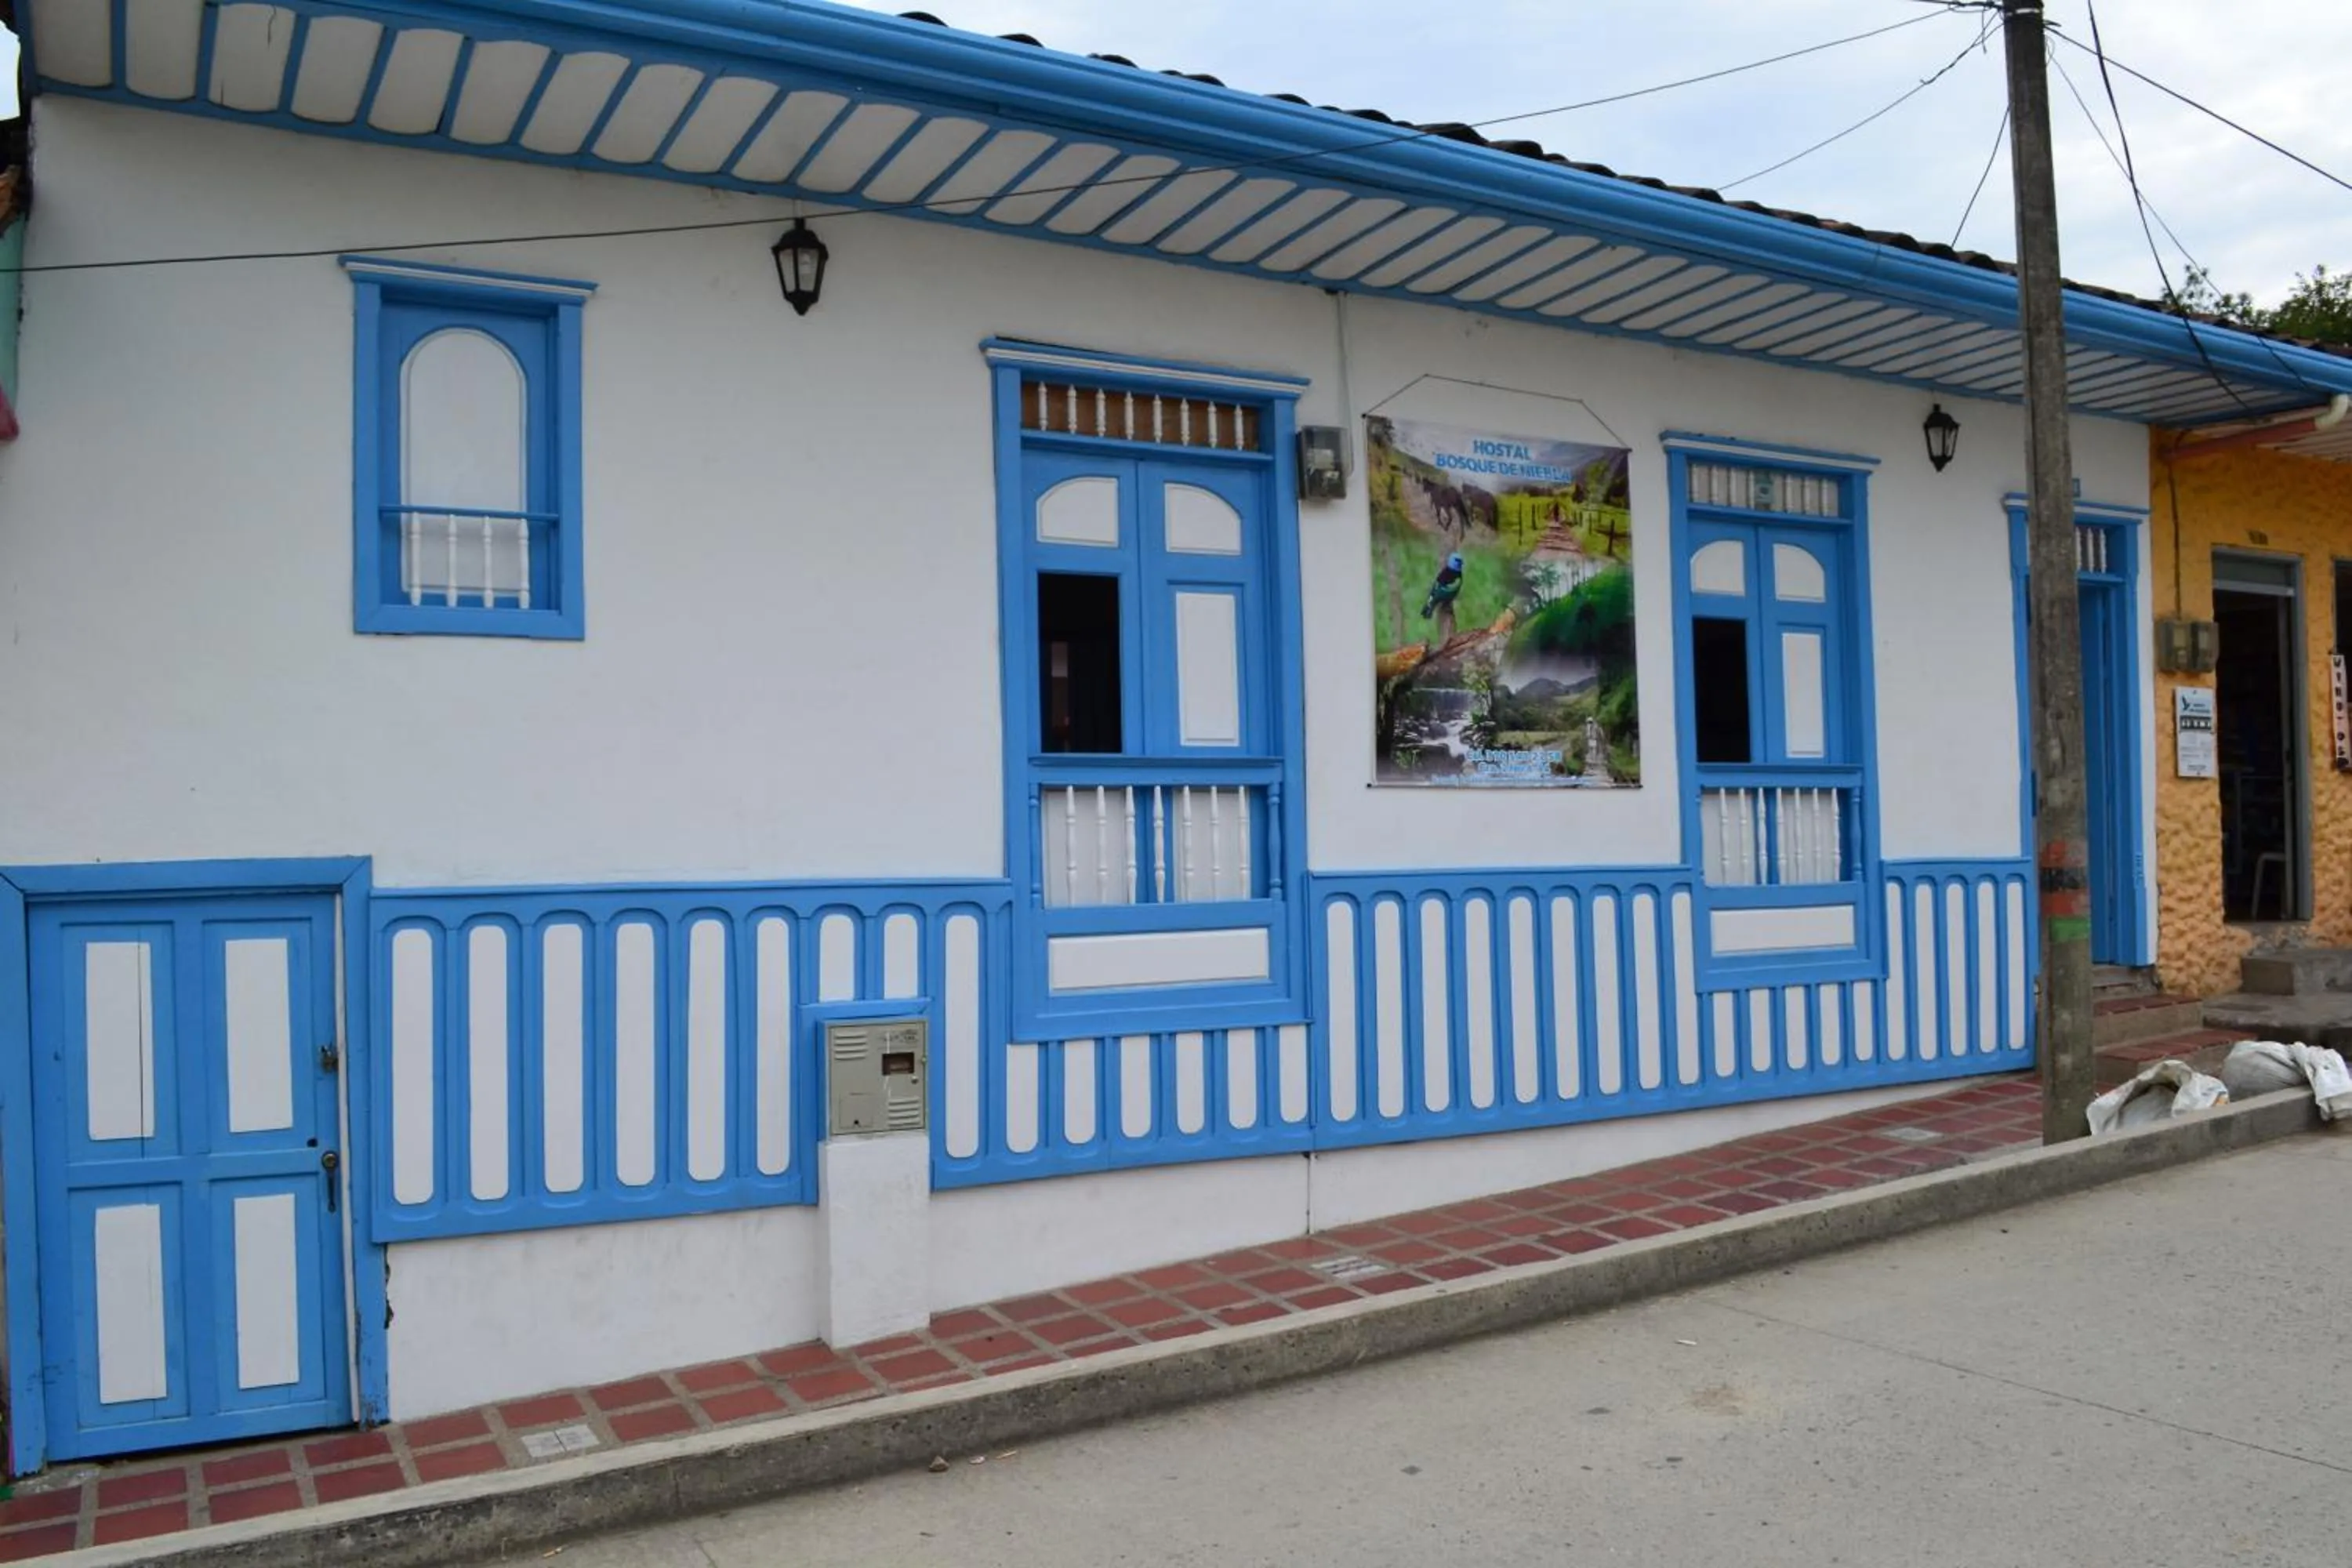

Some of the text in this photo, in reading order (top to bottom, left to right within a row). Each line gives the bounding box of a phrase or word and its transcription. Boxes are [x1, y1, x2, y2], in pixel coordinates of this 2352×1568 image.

[1473, 440, 1531, 460] HOSTAL
[1436, 455, 1495, 474] BOSQUE
[1498, 463, 1518, 476] DE
